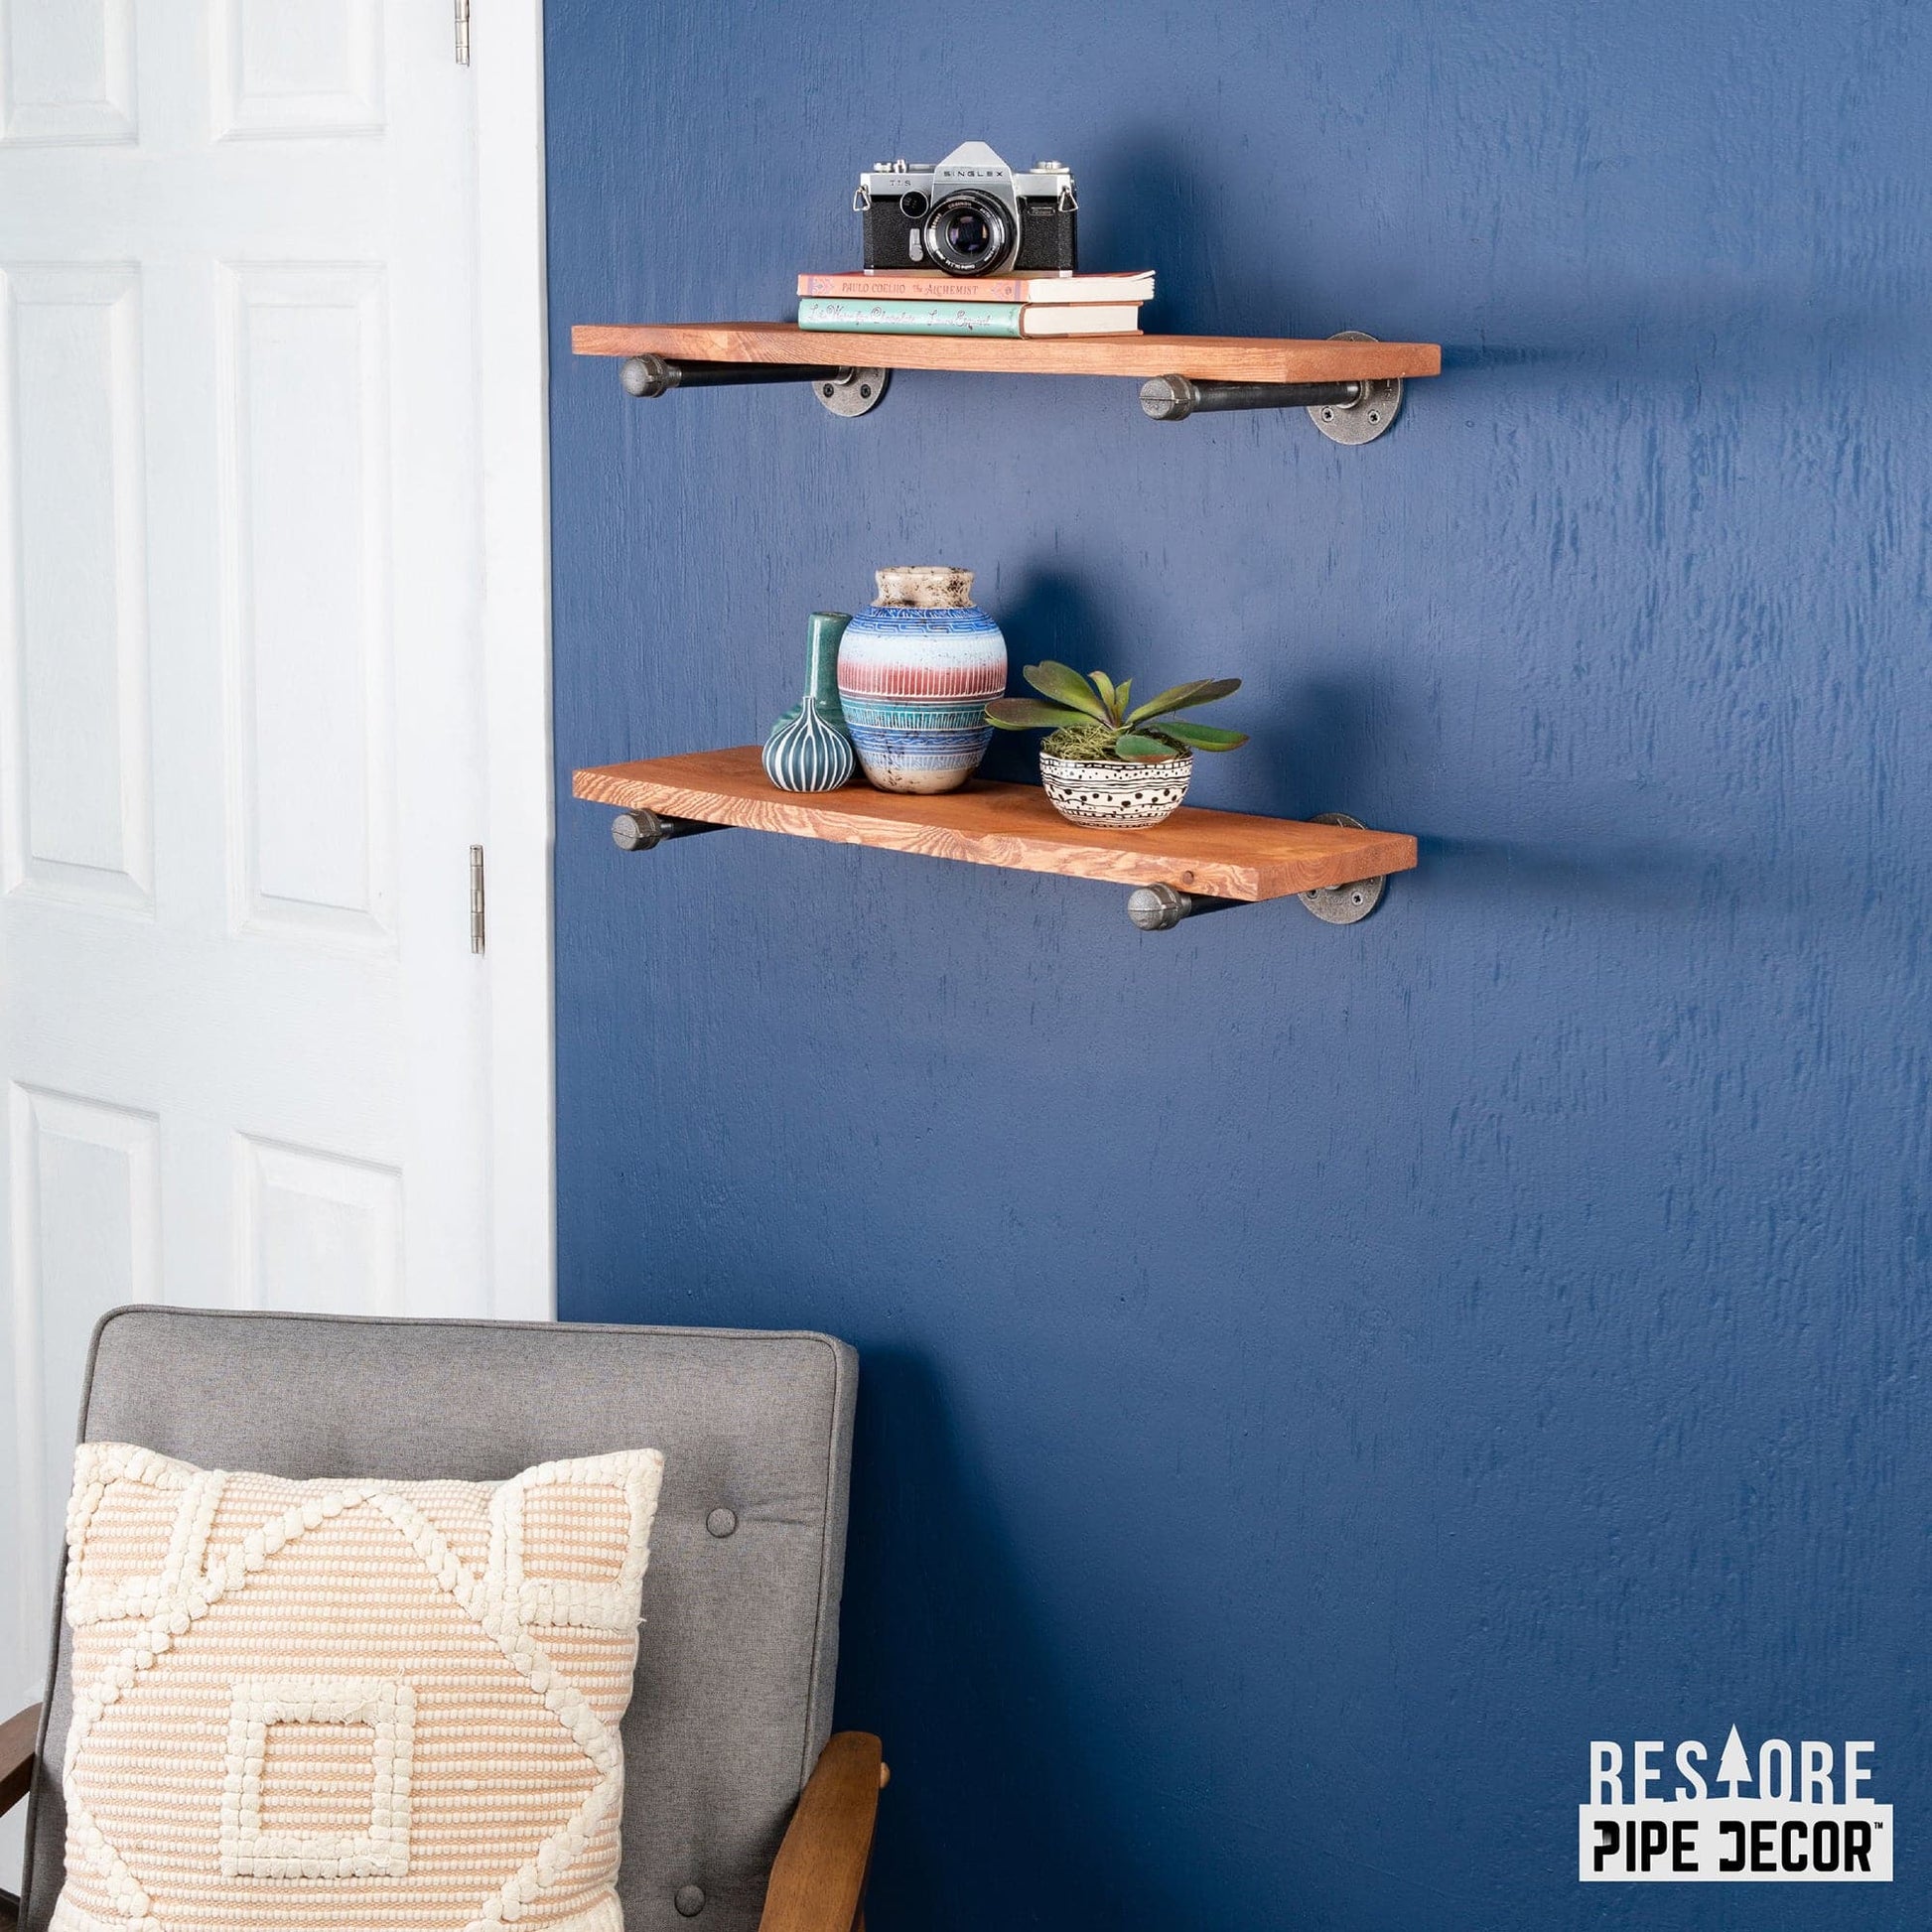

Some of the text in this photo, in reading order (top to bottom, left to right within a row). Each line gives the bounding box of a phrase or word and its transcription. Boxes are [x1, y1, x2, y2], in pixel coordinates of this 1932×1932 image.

[842, 282, 869, 293] PAULO
[872, 284, 906, 294] COELHO
[924, 284, 979, 297] ALCHEMIST
